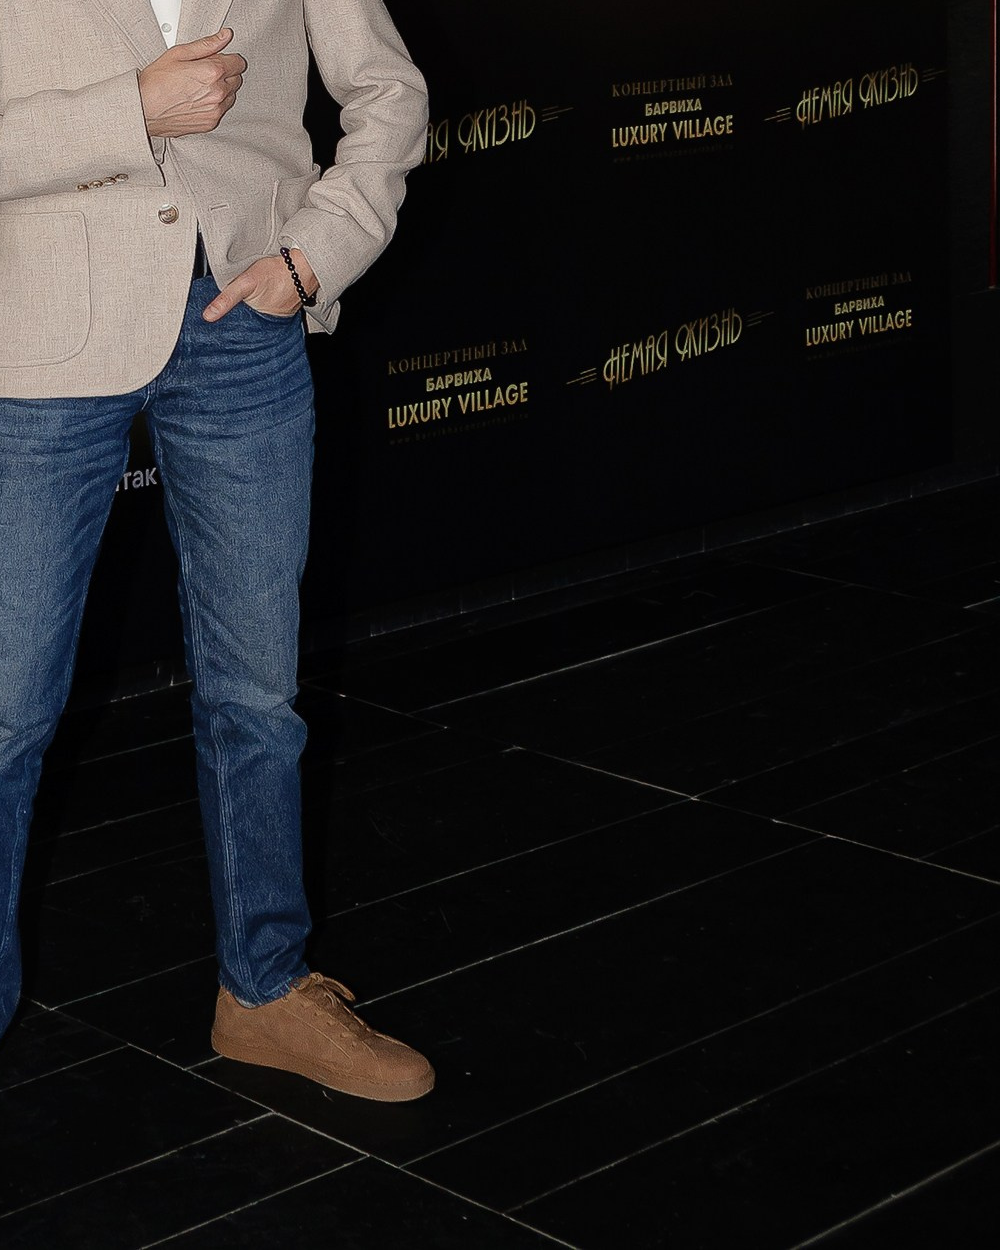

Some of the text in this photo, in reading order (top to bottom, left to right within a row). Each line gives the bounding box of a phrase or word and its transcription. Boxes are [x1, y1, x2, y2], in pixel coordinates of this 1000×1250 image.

[612, 73, 733, 97] КОНЦЕРТНЫЙ ЗАЛ
[796, 62, 919, 130] НЕМАЯ ЖИЗНЬ
[458, 98, 536, 155] ЖИЗНЬ
[645, 98, 702, 117] БАРВИХА
[611, 114, 734, 149] LUXURY VILLAGE
[833, 294, 885, 316] БАРВИХА
[805, 321, 855, 348] LUXURY
[858, 308, 913, 336] VILLAGE
[387, 338, 529, 376] КОНЦЕРТНЫЙ ЗАЛ
[602, 330, 668, 390] НЕМАЯ
[676, 307, 743, 362] ЖИЗНЬ
[425, 367, 492, 393] БАРВИХА
[387, 381, 529, 430] LUXURY VILLAGE
